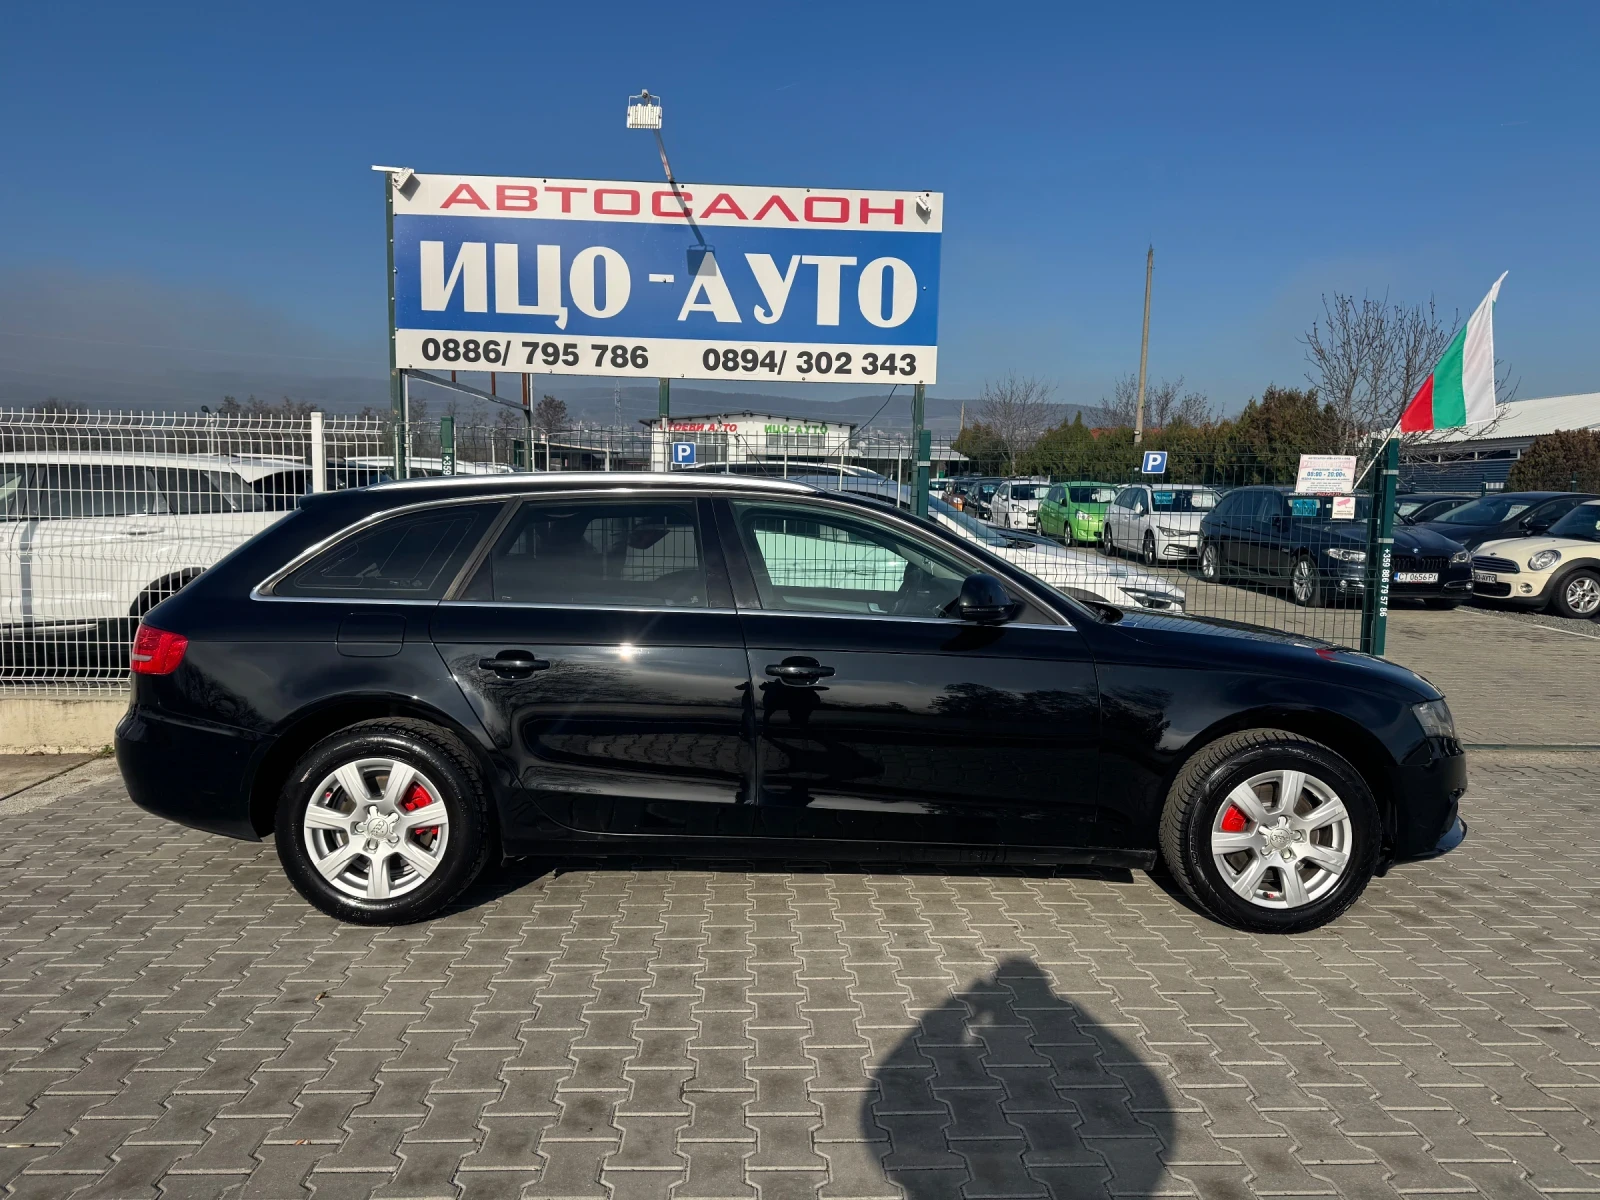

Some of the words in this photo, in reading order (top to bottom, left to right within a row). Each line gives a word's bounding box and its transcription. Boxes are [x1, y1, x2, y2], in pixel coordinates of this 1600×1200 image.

[439, 183, 905, 225] АВТОСАЛОН
[419, 240, 632, 331] ИЦО
[421, 337, 512, 368] 0886/
[522, 341, 580, 368] 795
[590, 343, 650, 369] 786
[702, 346, 788, 376] 0894/
[795, 350, 855, 375] 302
[860, 352, 918, 377] 343
[707, 423, 738, 432] АТО
[678, 444, 691, 462] P
[1147, 454, 1162, 470] P
[443, 455, 452, 475] +359
[1382, 548, 1391, 568] +359
[1381, 569, 1390, 583] 886
[1380, 585, 1389, 594] 79
[1380, 596, 1389, 605] 57
[1379, 607, 1388, 617] 86
